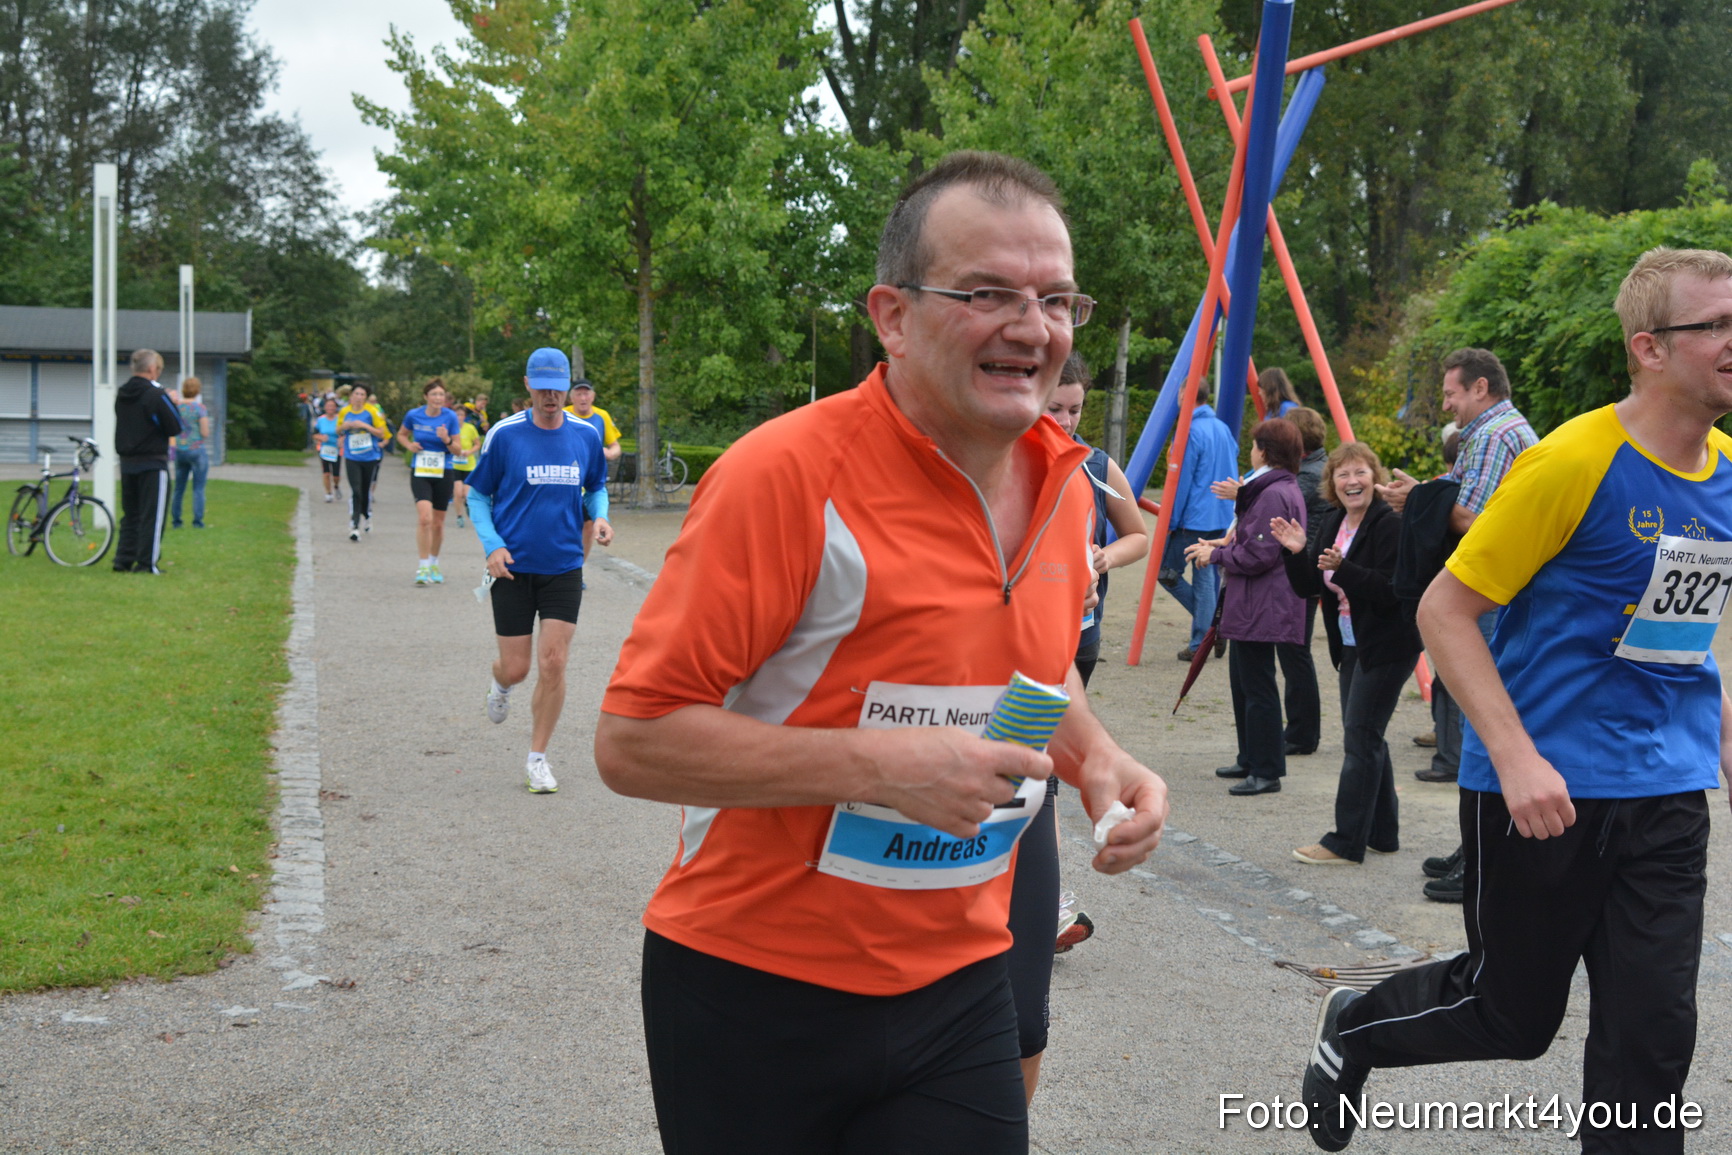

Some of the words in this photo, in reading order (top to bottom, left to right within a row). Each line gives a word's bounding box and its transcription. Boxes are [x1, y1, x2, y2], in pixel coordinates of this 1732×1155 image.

[421, 457, 438, 467] 106
[526, 465, 580, 478] HUBER
[1642, 510, 1652, 518] 15
[1637, 521, 1658, 529] Jahre
[1660, 549, 1697, 564] PARTL
[1653, 570, 1732, 616] 3321
[867, 702, 940, 727] PARTL
[883, 832, 988, 862] Andreas
